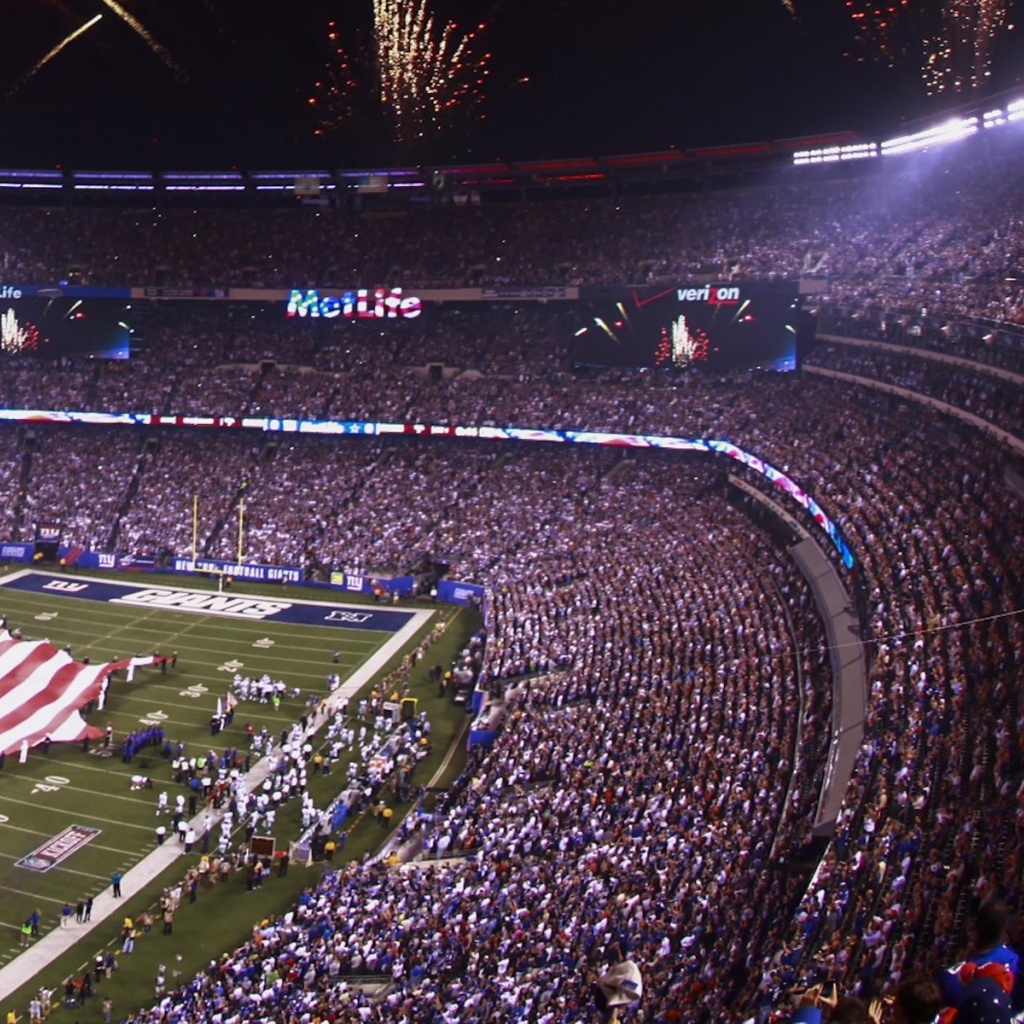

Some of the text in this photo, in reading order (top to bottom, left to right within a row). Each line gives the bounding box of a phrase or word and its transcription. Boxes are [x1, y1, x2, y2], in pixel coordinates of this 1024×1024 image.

[286, 287, 423, 318] MetLife
[677, 284, 740, 304] verizon
[175, 560, 195, 572] NEW
[223, 564, 264, 579] FOOTBALL
[108, 589, 293, 619] GIANTS
[36, 775, 71, 793] 40
